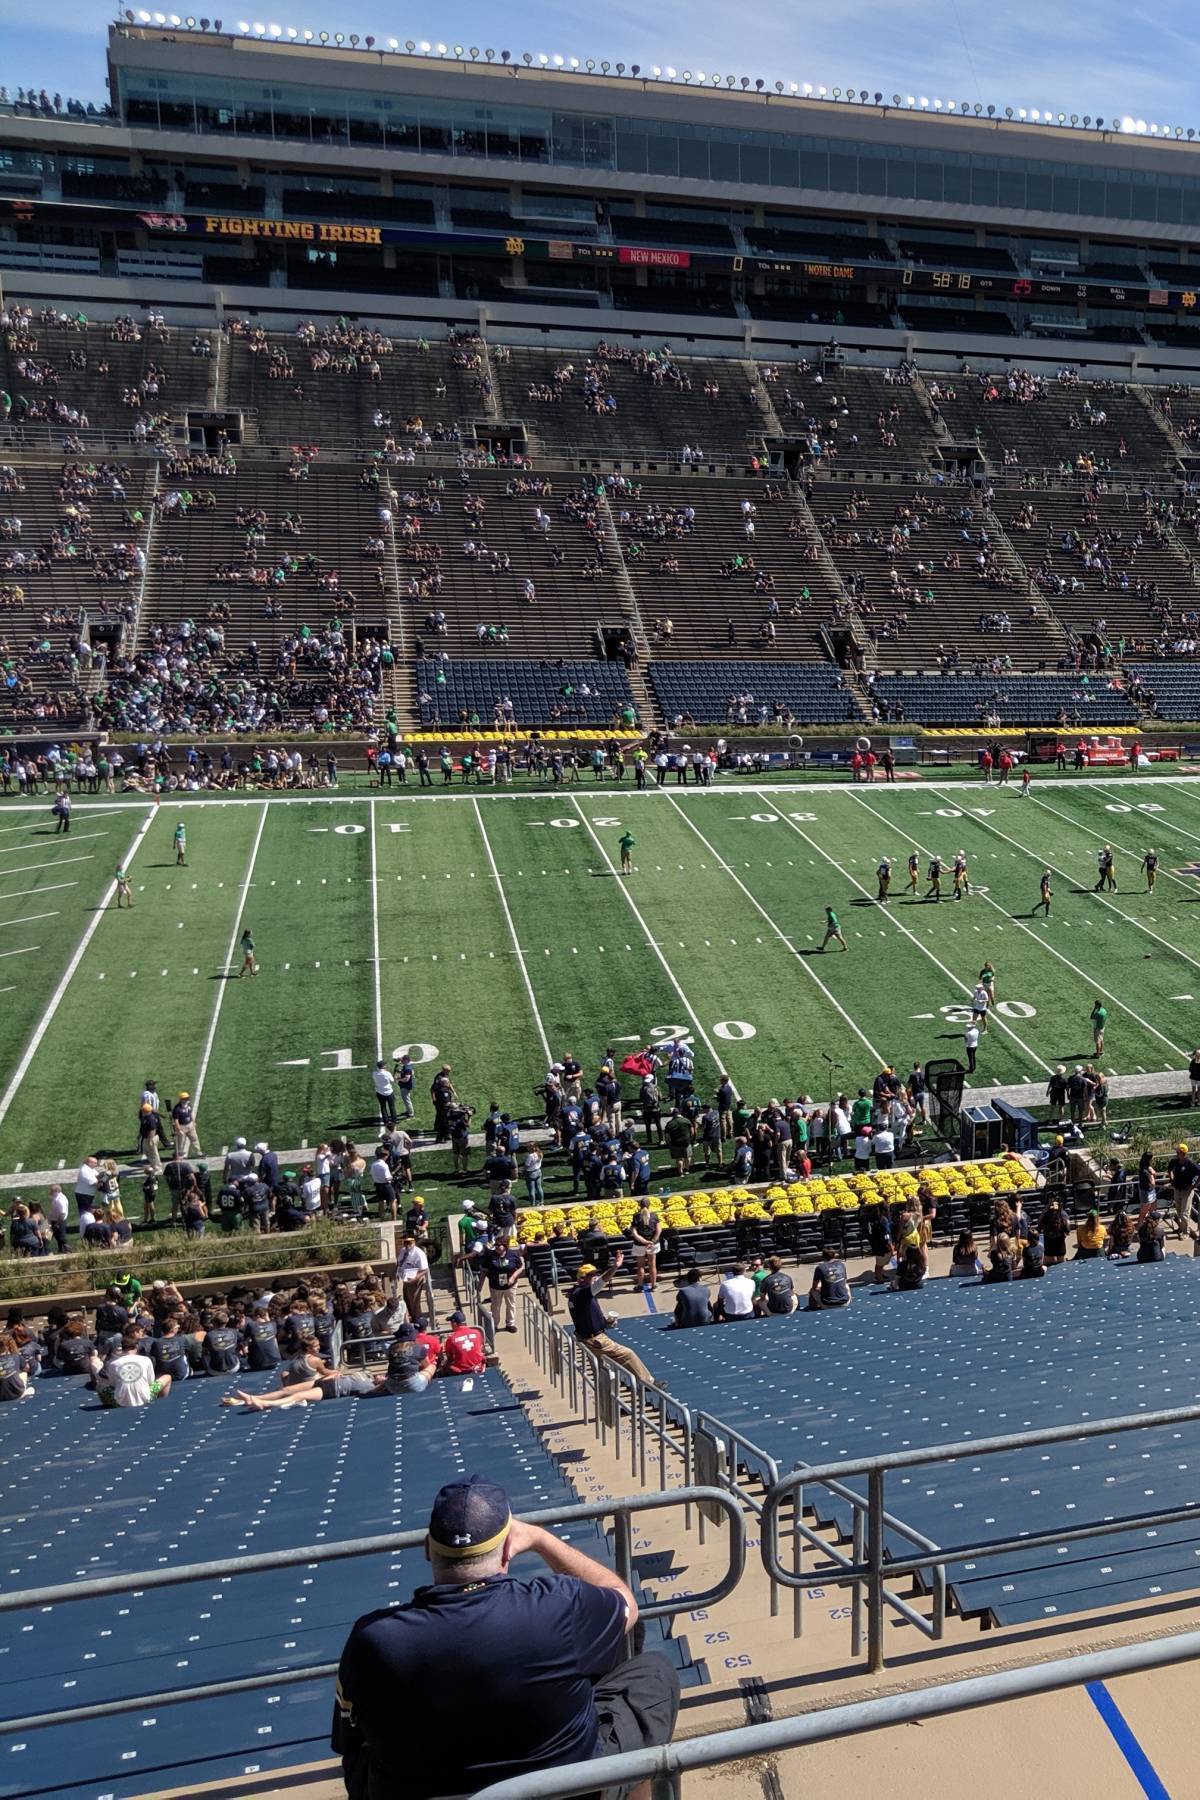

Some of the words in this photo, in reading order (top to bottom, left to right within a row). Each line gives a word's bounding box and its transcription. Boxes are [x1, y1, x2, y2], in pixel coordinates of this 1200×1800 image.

[205, 216, 314, 240] FIGHTING
[319, 224, 382, 244] IRISH
[630, 250, 649, 263] NEW
[651, 251, 679, 265] MEXICO
[808, 265, 832, 277] NOTRE
[833, 267, 854, 279] DAME
[932, 272, 971, 289] 58:18
[634, 1540, 653, 1550] 47
[807, 1588, 826, 1600] 51
[690, 1609, 709, 1622] 51
[828, 1606, 852, 1620] 52
[704, 1631, 731, 1645] 52
[724, 1654, 752, 1669] 53
